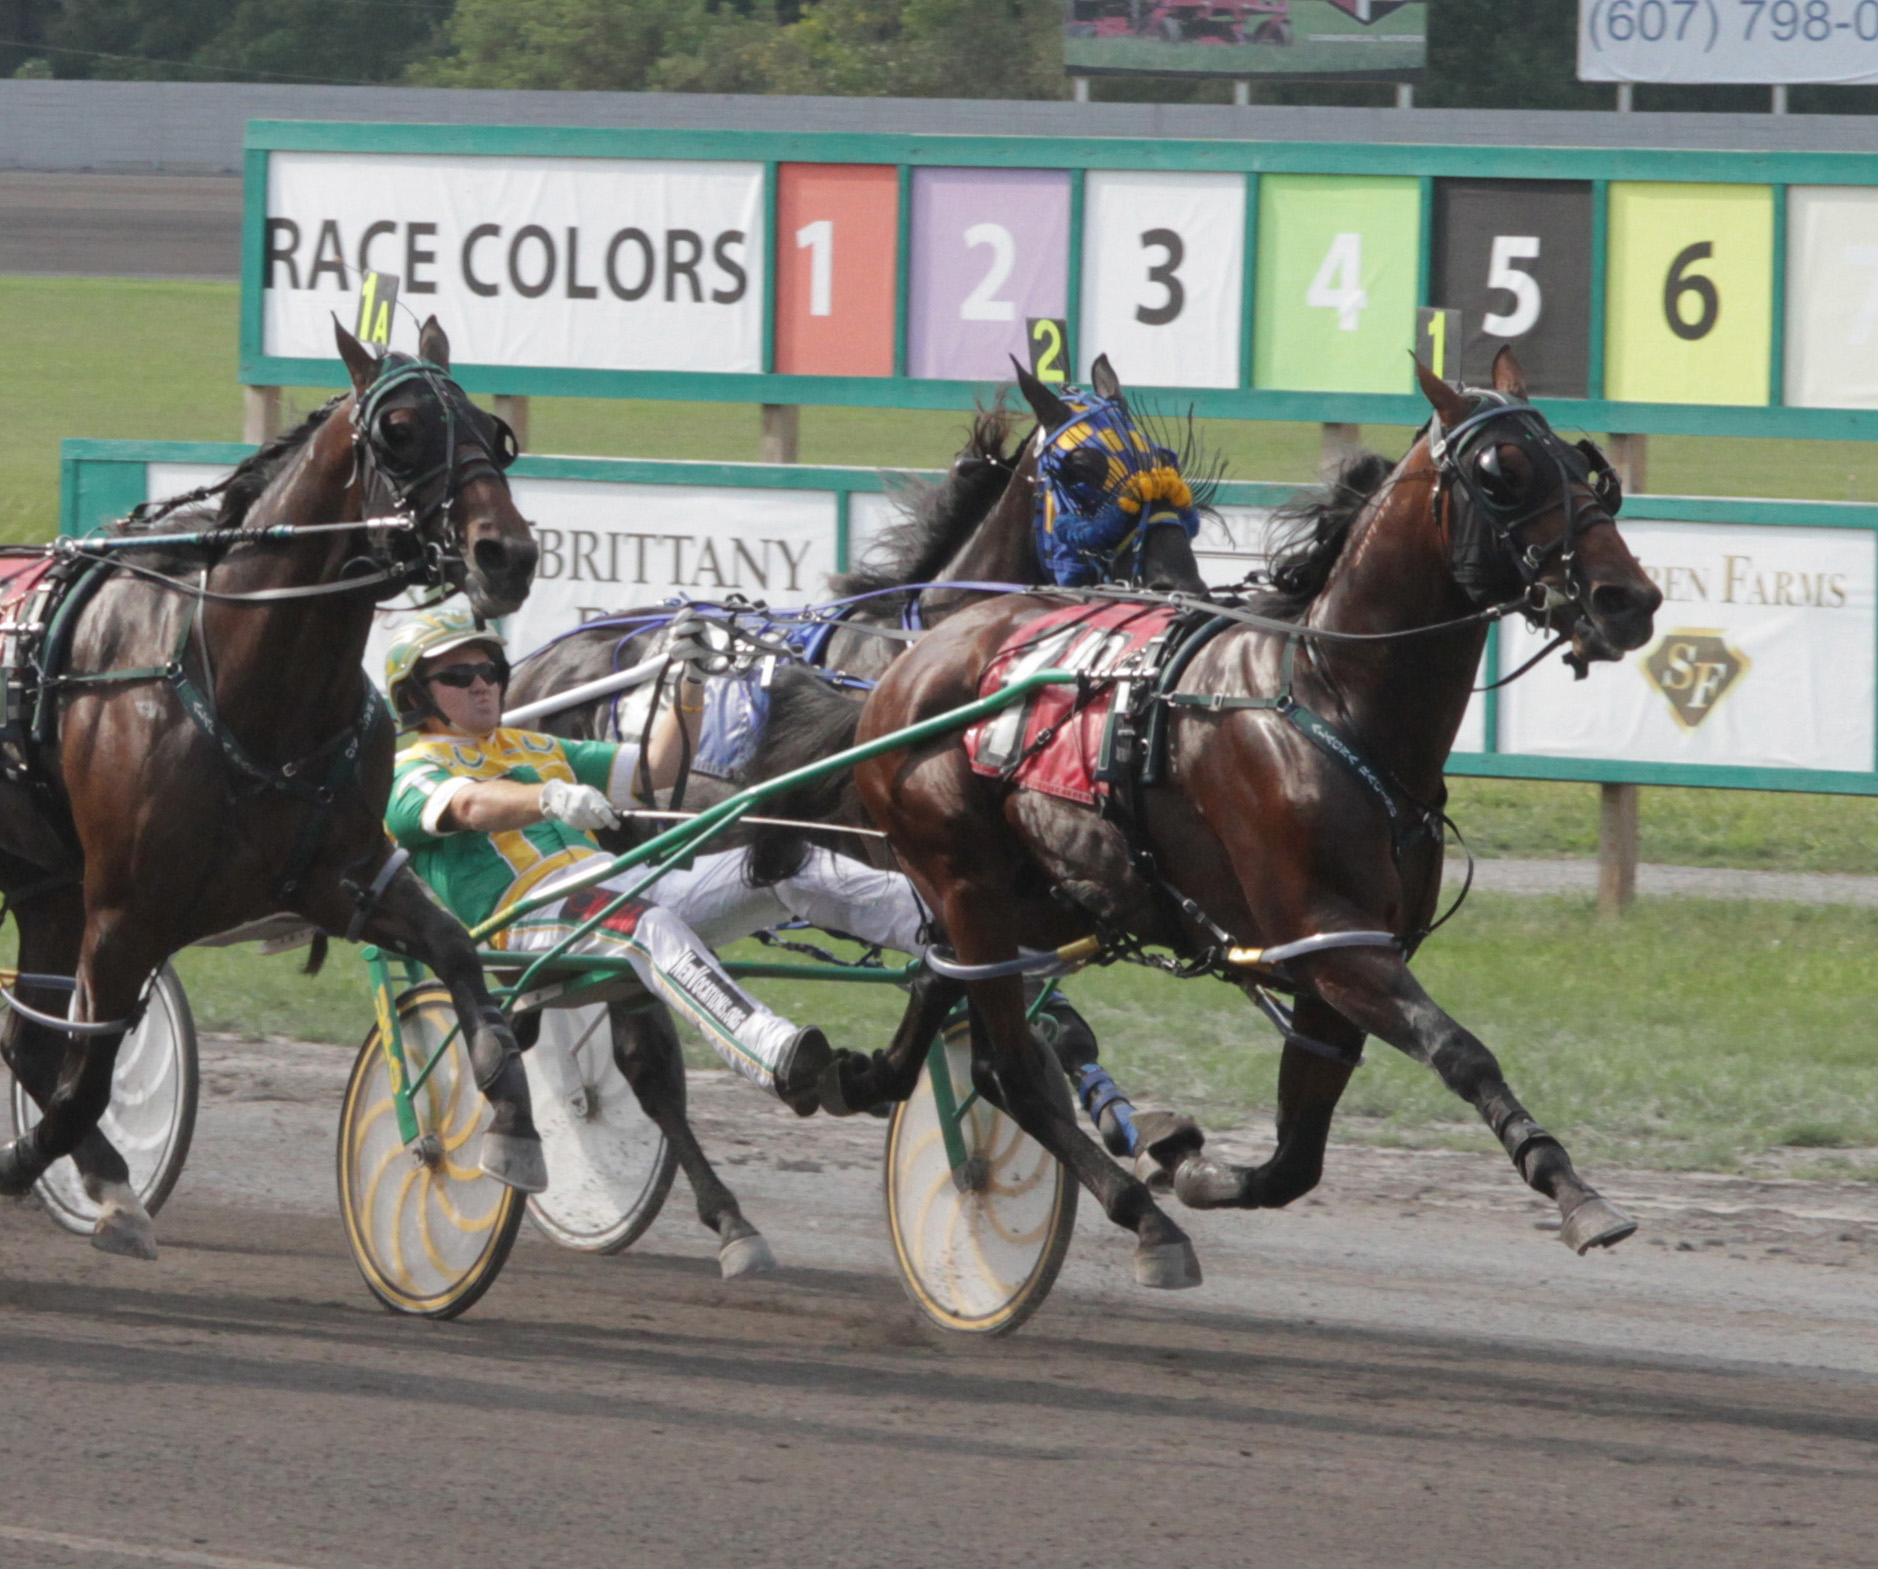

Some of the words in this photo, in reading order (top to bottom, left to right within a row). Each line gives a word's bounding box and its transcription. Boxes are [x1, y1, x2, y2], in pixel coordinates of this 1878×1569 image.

[1589, 0, 1719, 52] (607)
[264, 217, 437, 293] RACE
[460, 223, 747, 305] COLORS
[795, 219, 833, 317] 1
[959, 222, 1017, 322] 2
[1134, 227, 1186, 327] 3
[1305, 232, 1369, 332] 4
[1480, 235, 1541, 338] 5
[1663, 239, 1720, 342] 6
[359, 271, 389, 345] 1A
[1428, 310, 1446, 380] 1
[1033, 319, 1065, 383] 2
[535, 527, 812, 592] BRITTANY
[1720, 554, 1847, 609] FARMS
[1660, 642, 1728, 708] SF
